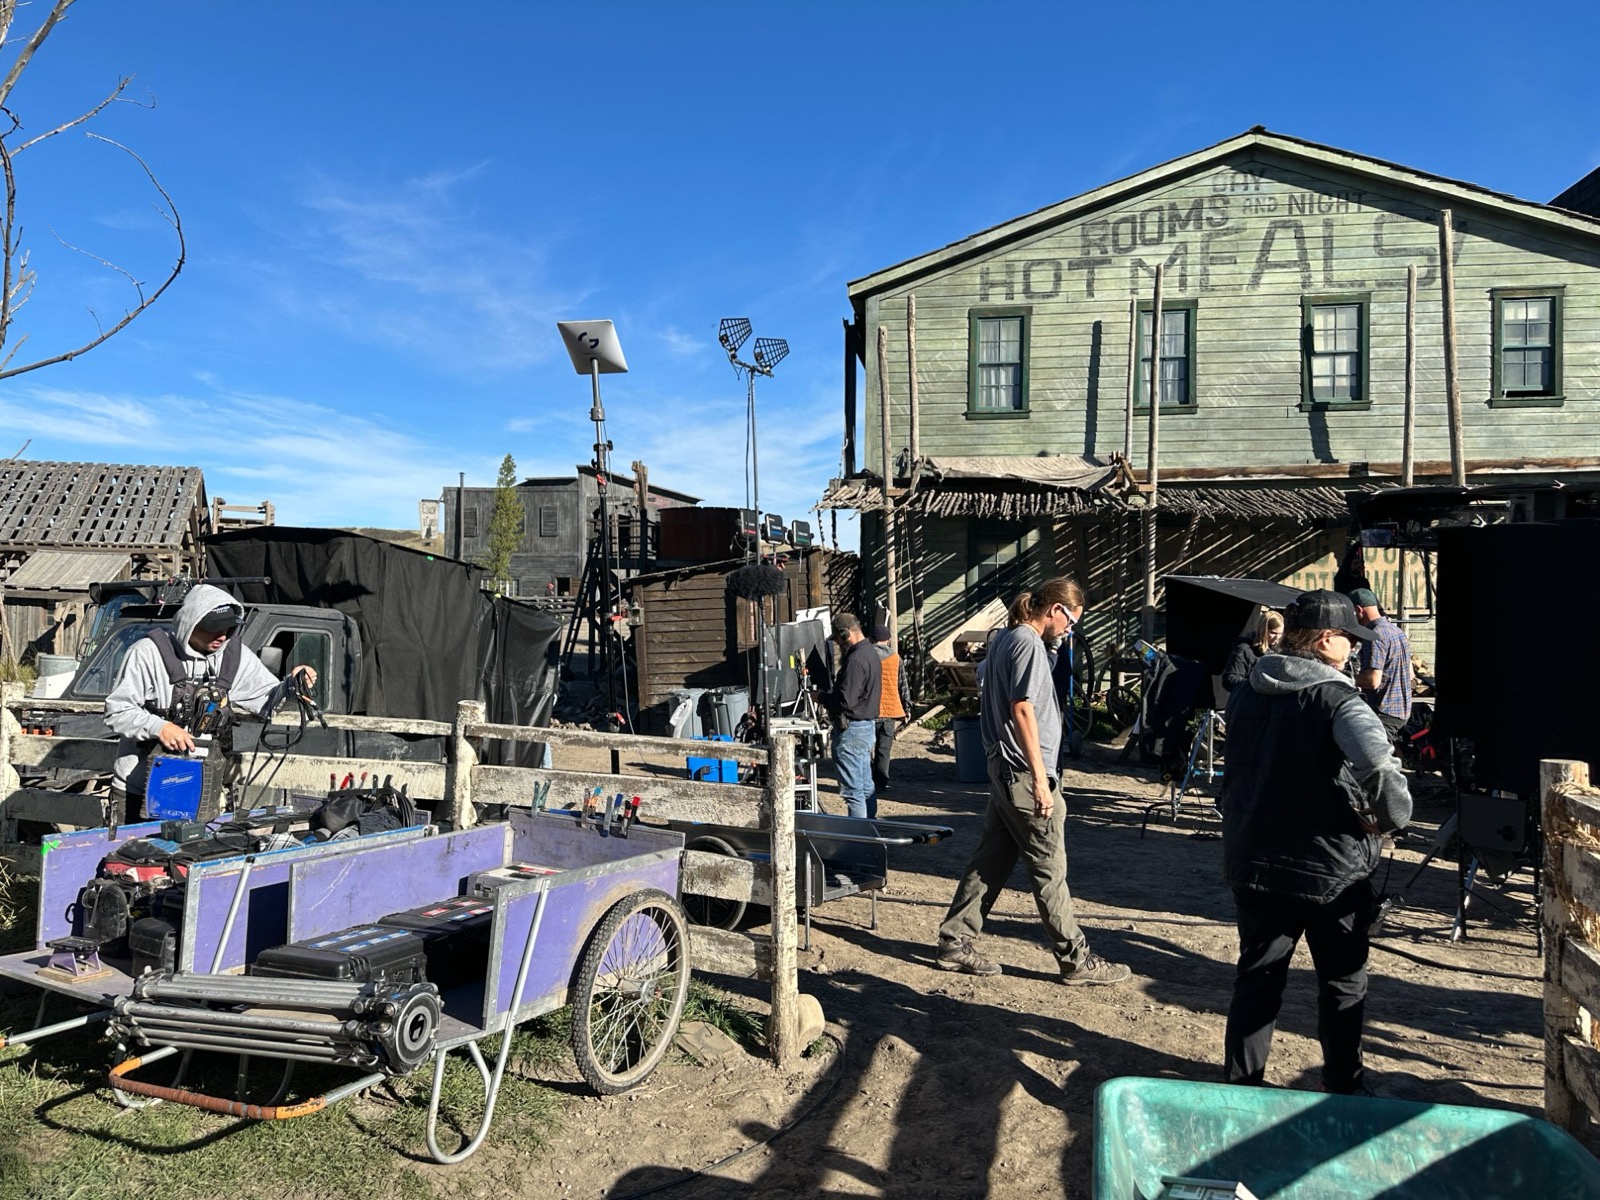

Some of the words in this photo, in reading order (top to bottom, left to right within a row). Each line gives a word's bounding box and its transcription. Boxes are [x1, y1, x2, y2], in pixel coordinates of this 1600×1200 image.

[1212, 168, 1265, 193] DAY
[1242, 197, 1278, 215] AND
[1288, 192, 1368, 215] NIGHT
[1080, 193, 1231, 256] ROOMS
[979, 258, 1112, 302] HOT
